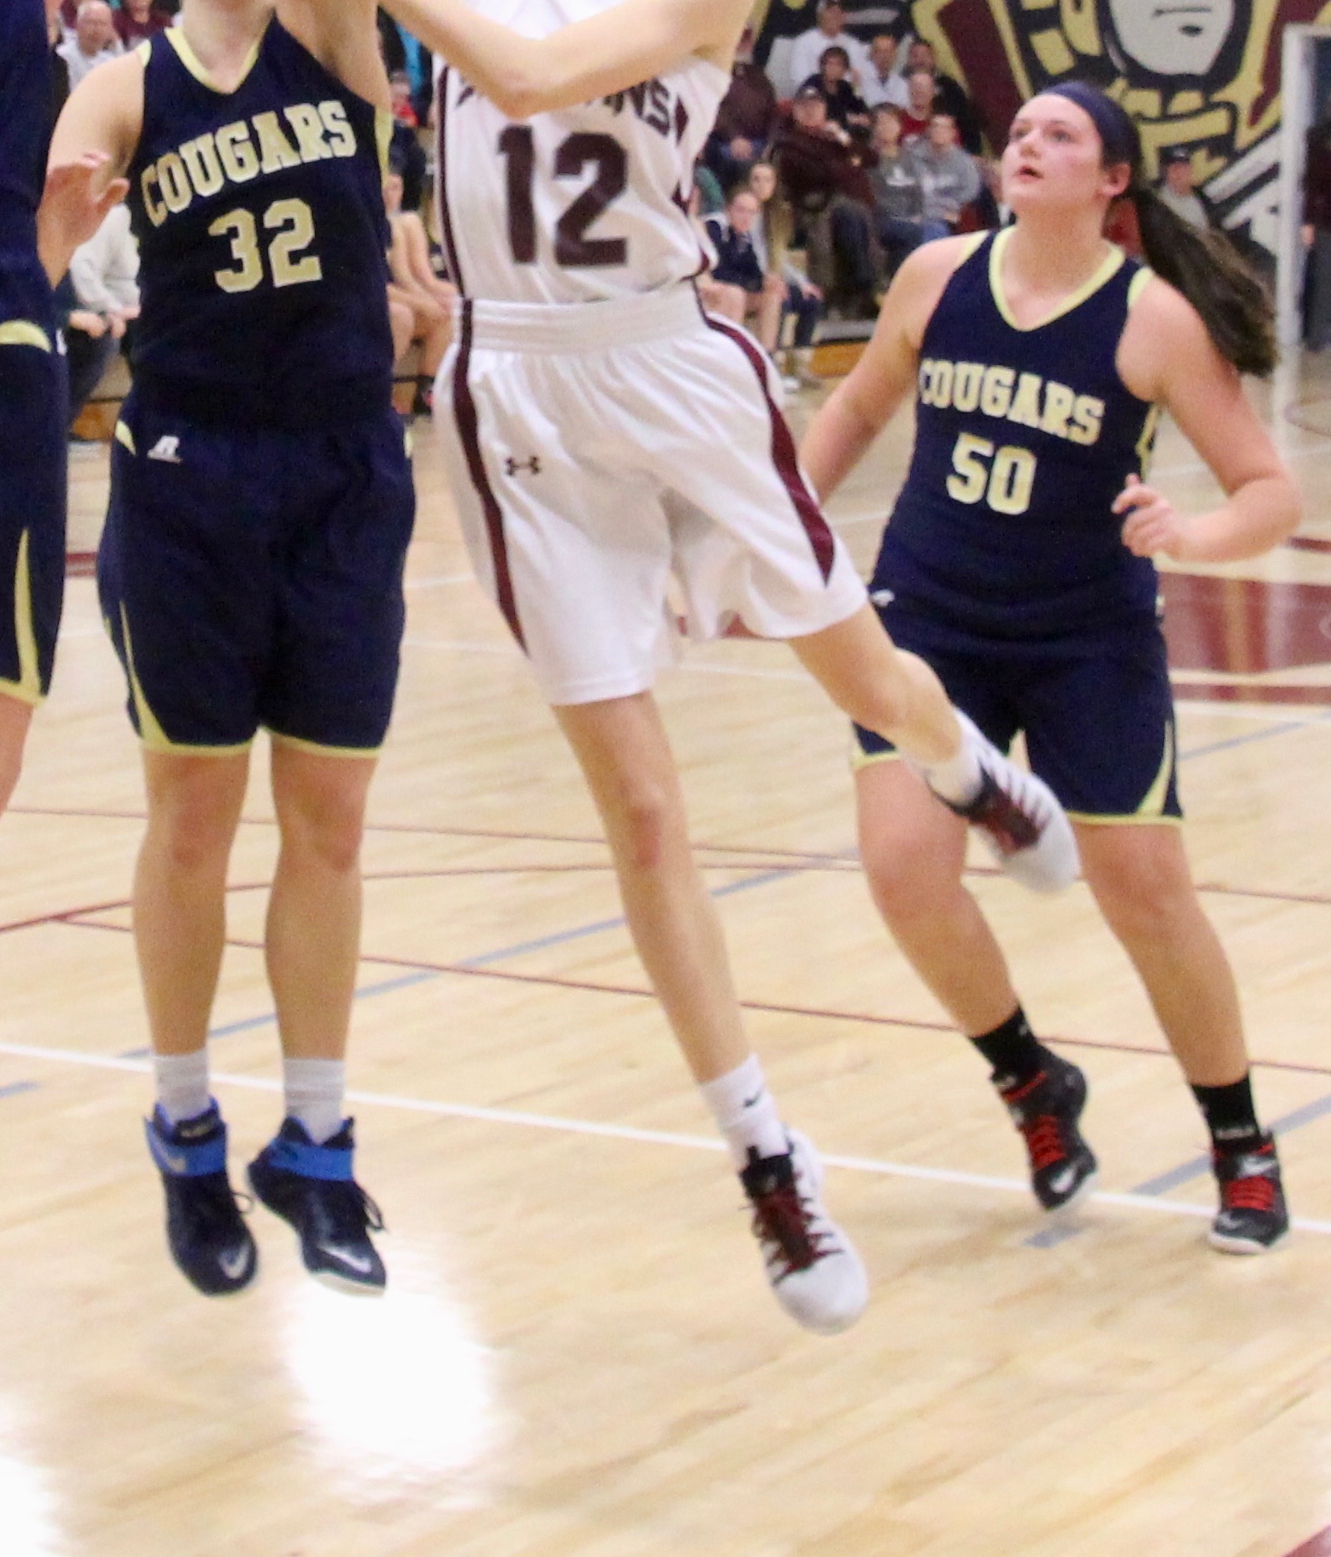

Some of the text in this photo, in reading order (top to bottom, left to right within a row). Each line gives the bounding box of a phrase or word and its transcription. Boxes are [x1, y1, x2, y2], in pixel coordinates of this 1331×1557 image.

[140, 99, 357, 228] COUGARS
[496, 123, 628, 267] 12
[207, 197, 323, 294] 32
[919, 357, 1106, 447] COUGARS
[945, 431, 1038, 516] 50
